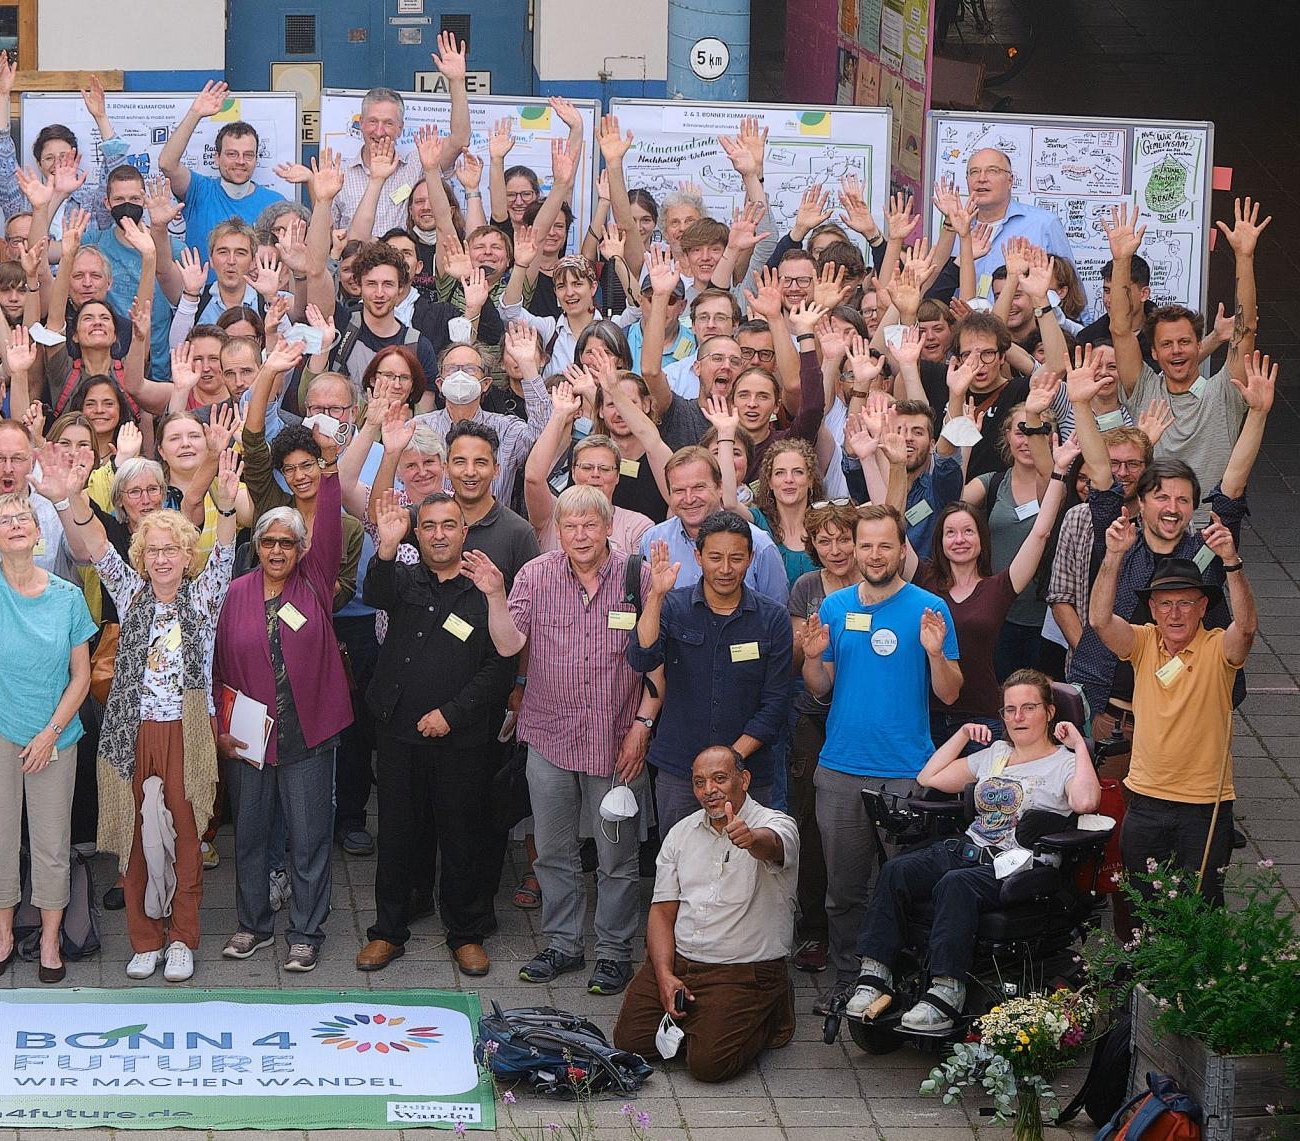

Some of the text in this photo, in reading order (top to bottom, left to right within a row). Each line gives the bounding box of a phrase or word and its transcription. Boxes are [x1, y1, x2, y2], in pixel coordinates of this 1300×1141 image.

[697, 51, 722, 66] 5 km
[420, 76, 486, 93] LAE-
[15, 1029, 297, 1050] BONN 4
[14, 1054, 296, 1073] FUTURE
[14, 1077, 404, 1088] WIR MACHEN WANDEL
